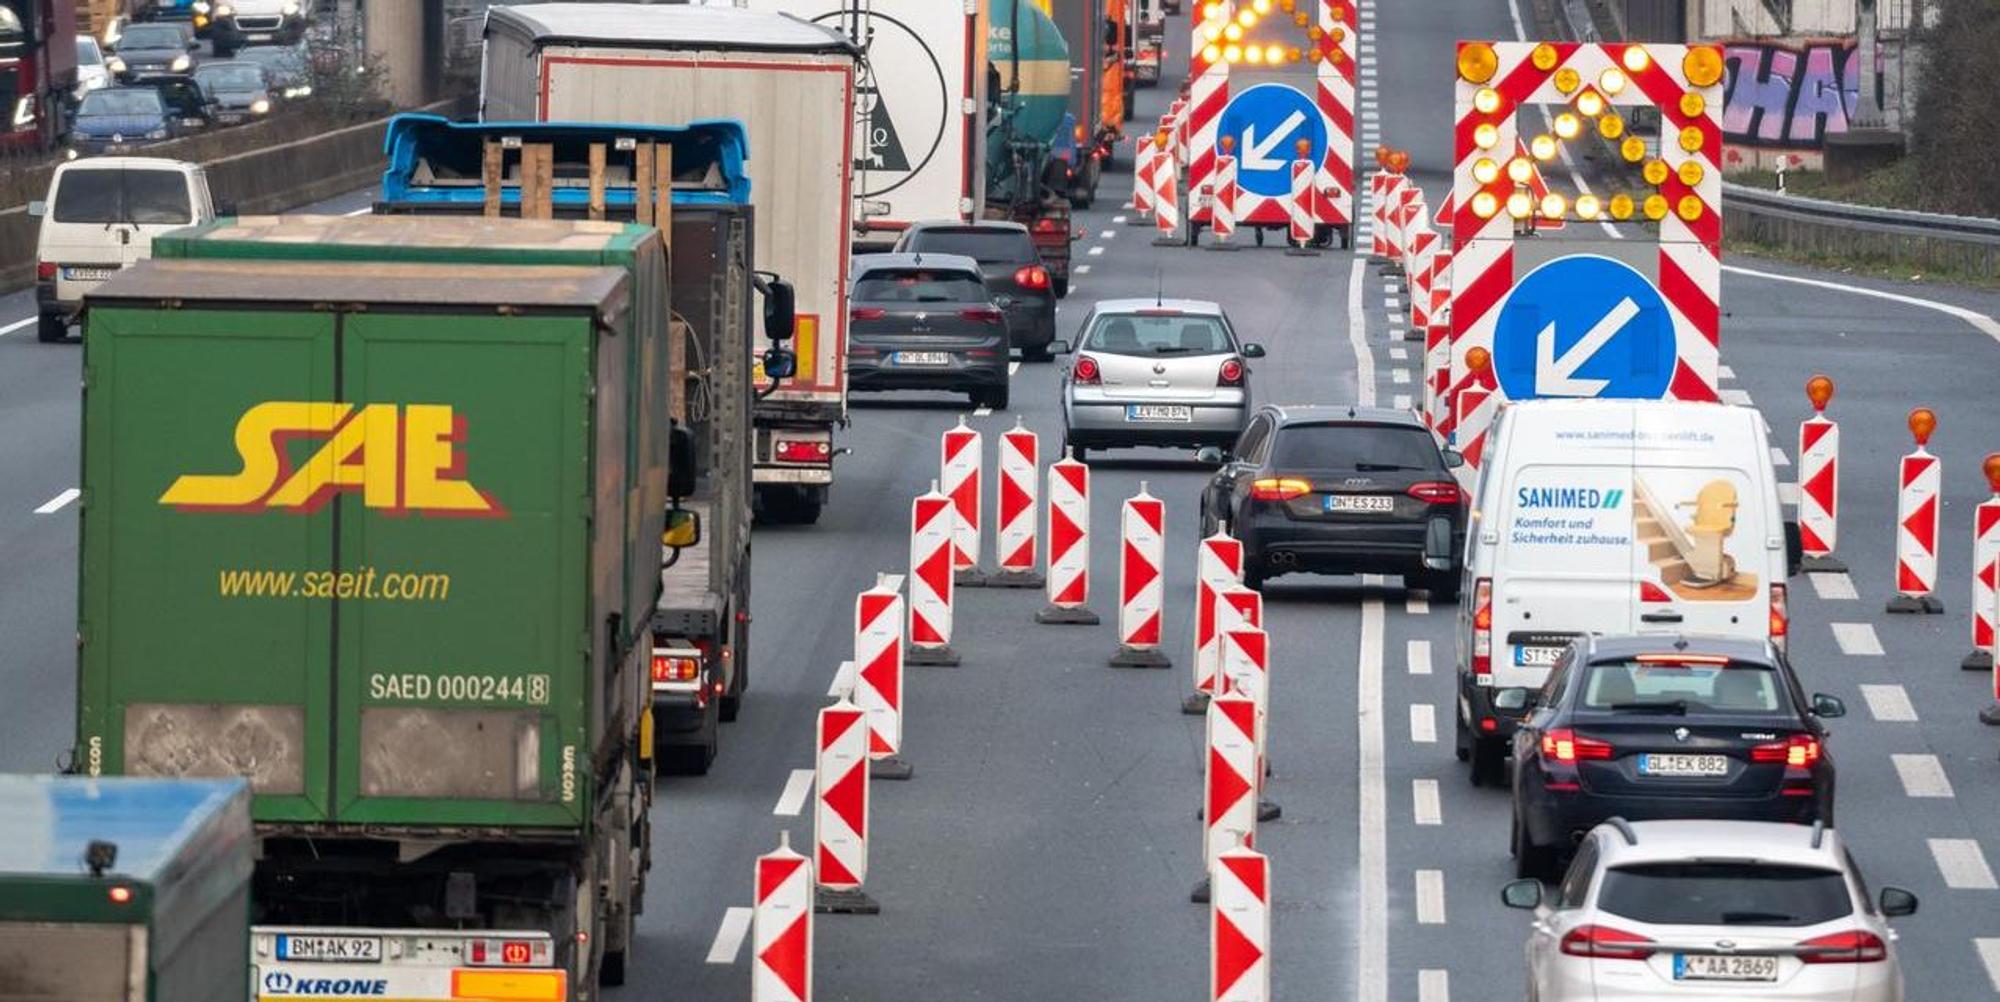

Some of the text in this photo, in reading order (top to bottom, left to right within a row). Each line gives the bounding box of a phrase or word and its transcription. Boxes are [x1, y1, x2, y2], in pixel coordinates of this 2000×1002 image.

[158, 401, 500, 513] SAE
[1370, 498, 1392, 509] 233
[1518, 487, 1601, 508] SANIMED
[1515, 517, 1593, 529] Komfort und
[1513, 532, 1632, 545] Sicherheit zuhause.
[219, 566, 450, 600] www.saeit.com
[370, 674, 431, 699] SAED
[437, 675, 524, 700] 000244
[1648, 756, 1725, 771] GL EK 882
[292, 939, 373, 956] BM AK 92
[1686, 957, 1775, 975] K AA 2869
[295, 979, 388, 995] KRONE
